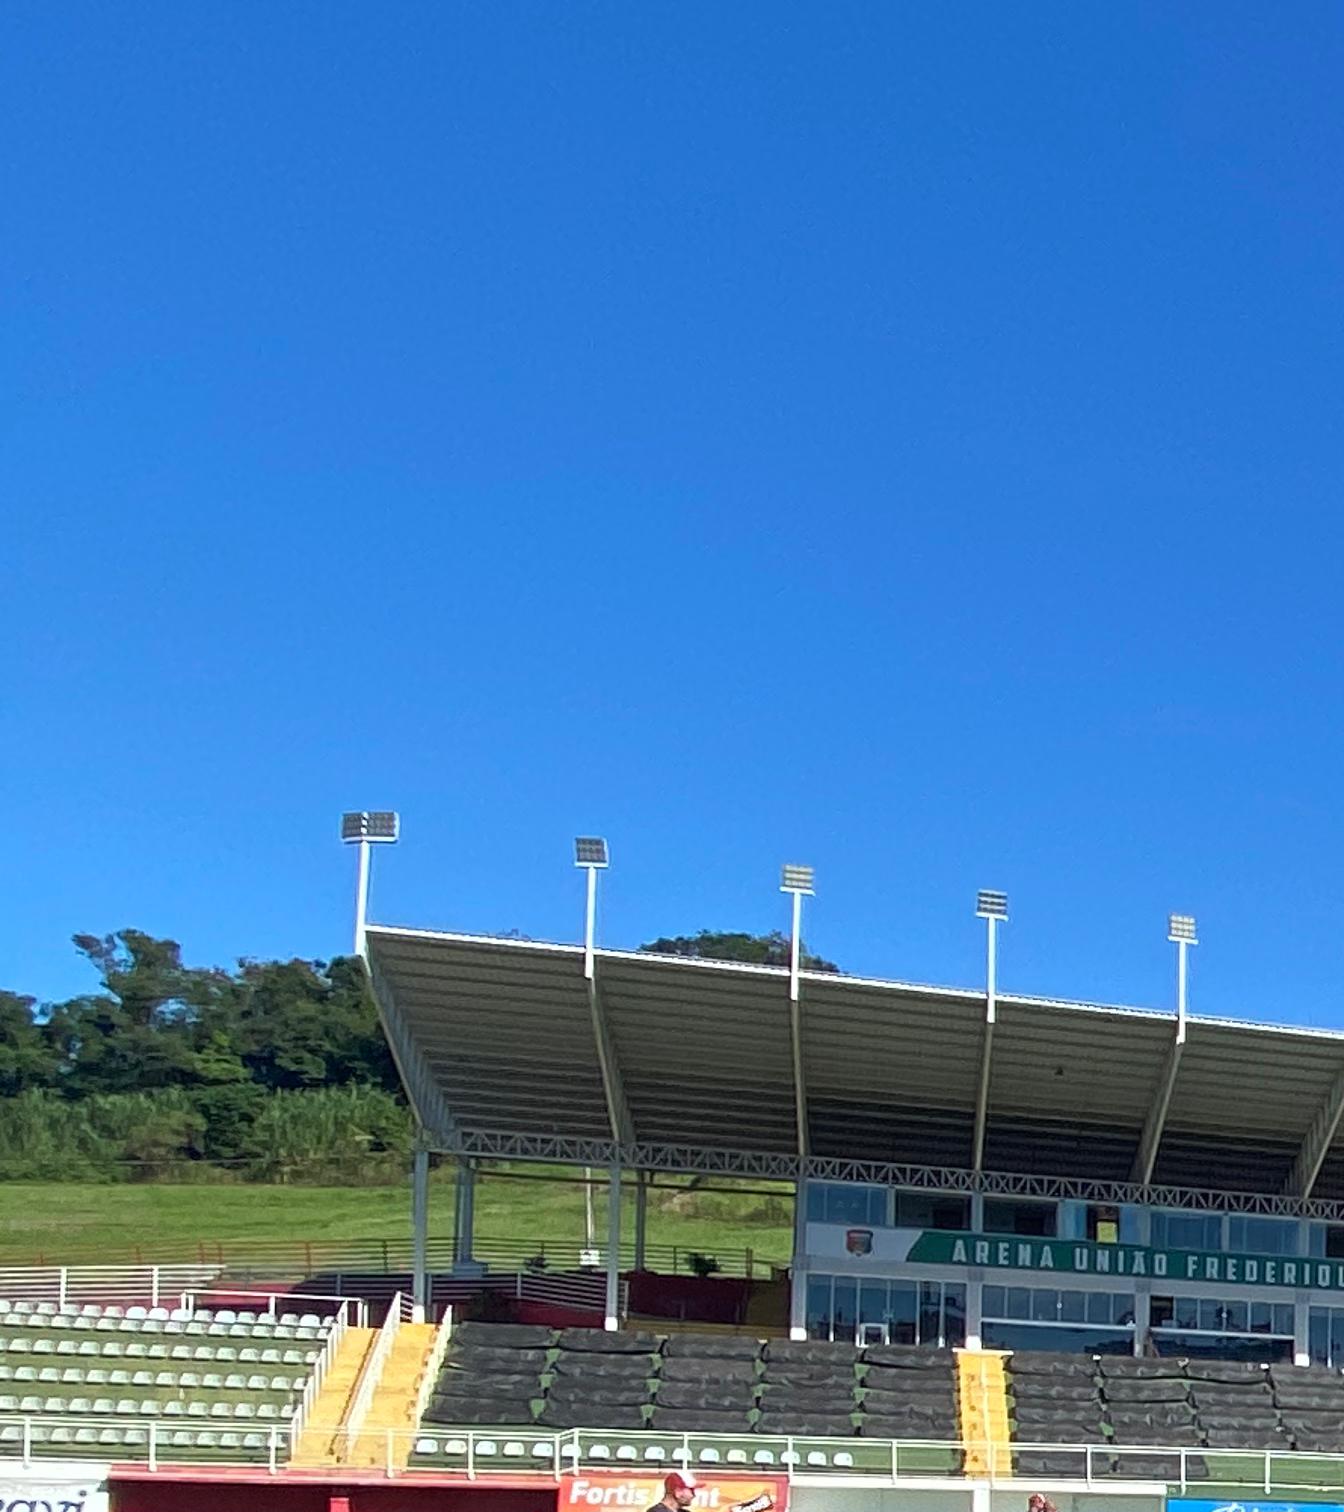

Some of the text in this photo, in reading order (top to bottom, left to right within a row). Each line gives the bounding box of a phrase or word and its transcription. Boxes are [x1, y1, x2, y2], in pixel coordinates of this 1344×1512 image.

[952, 1239, 1054, 1268] ARENA
[1074, 1246, 1168, 1276] UNIÃO
[570, 1481, 648, 1504] Fortis
